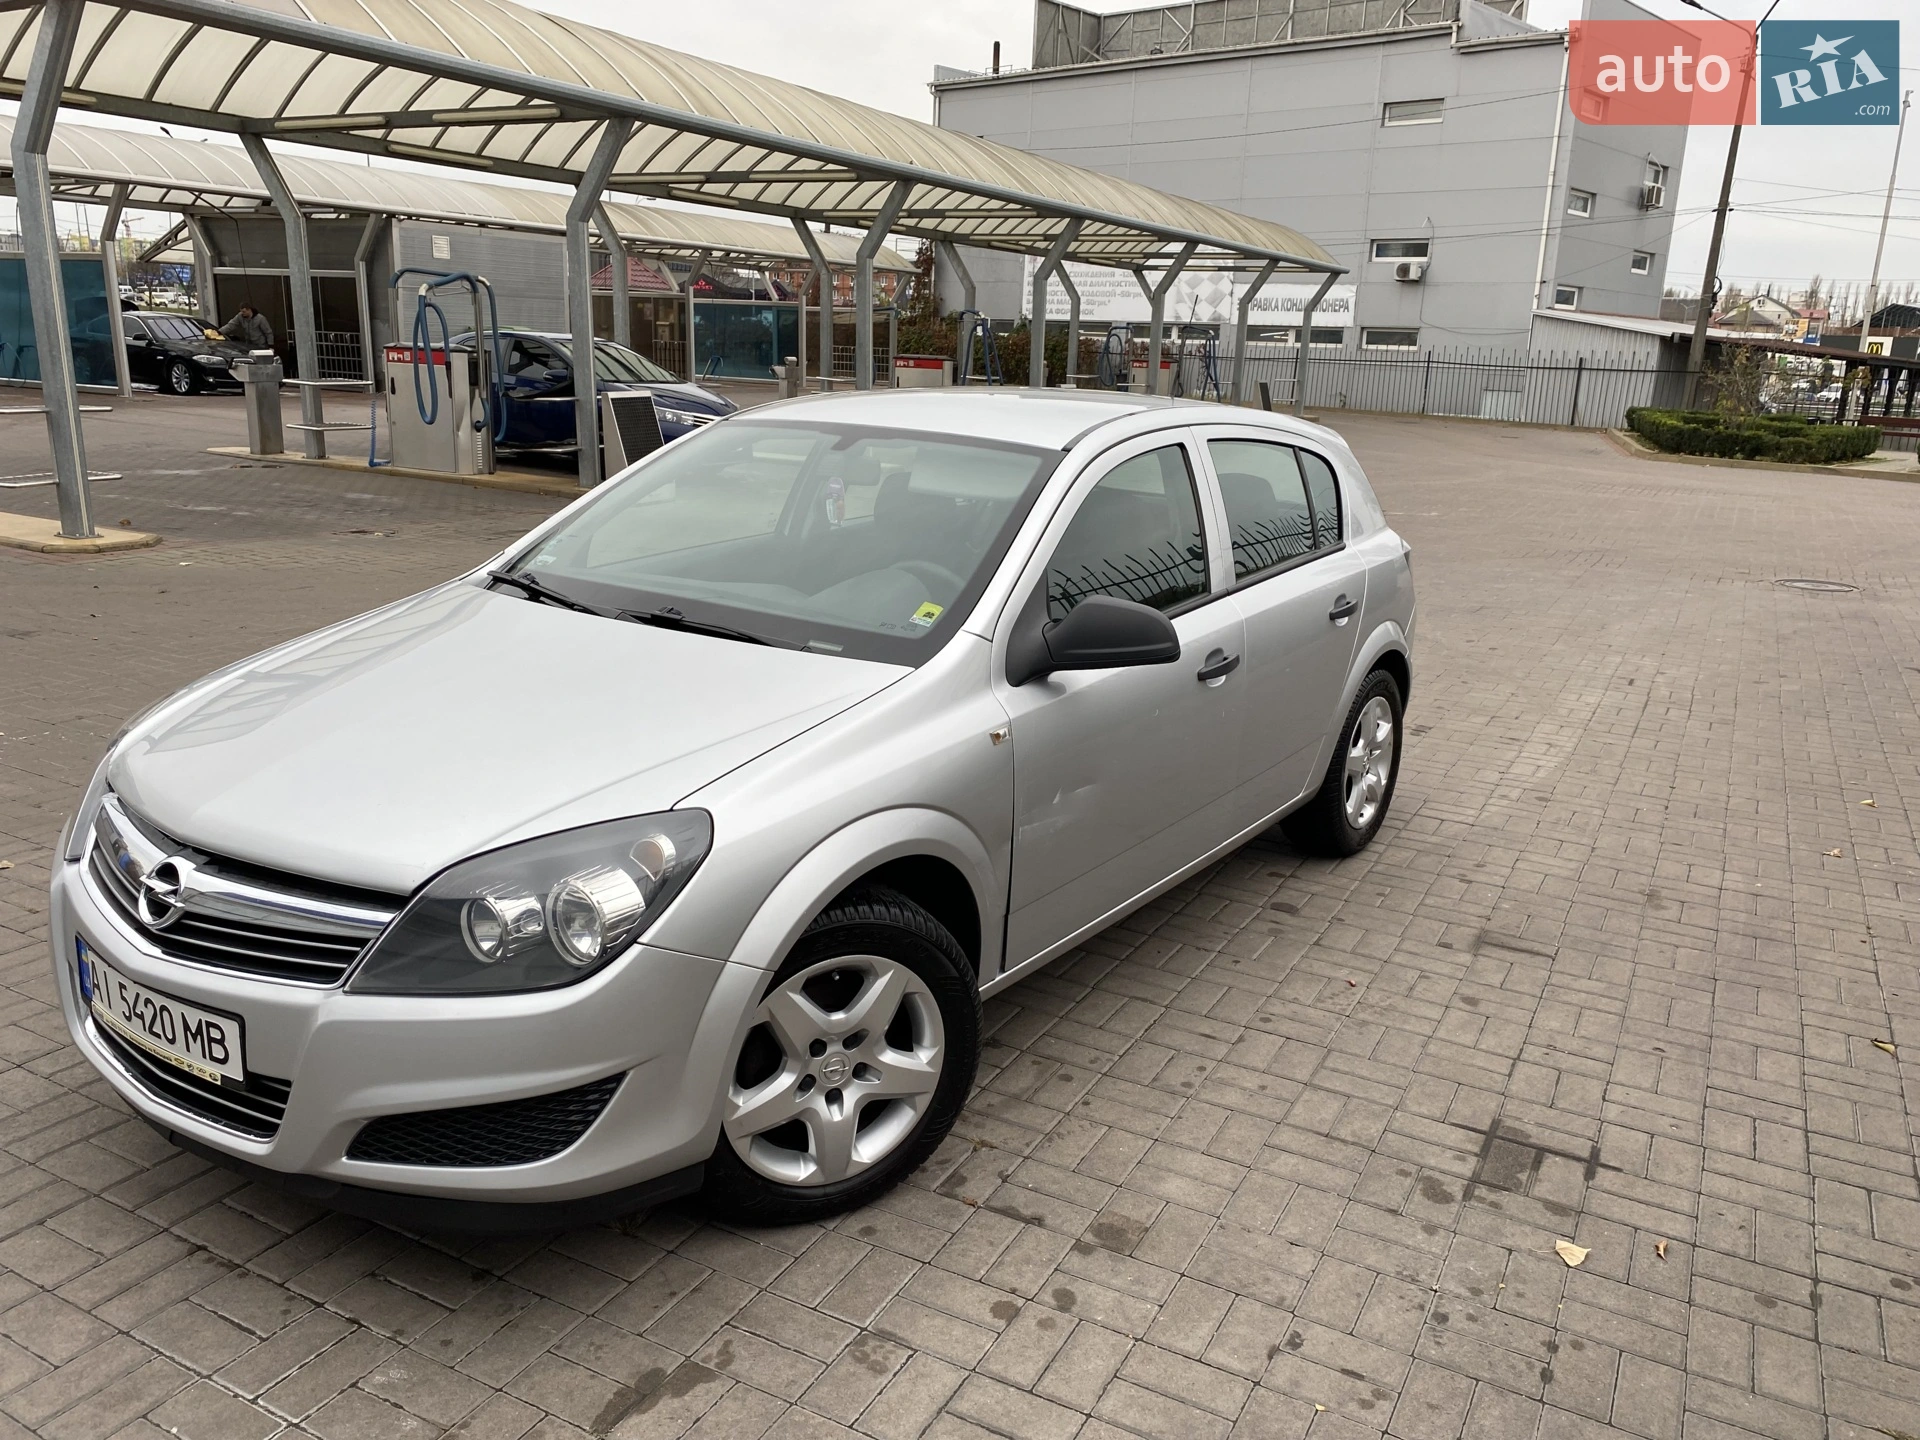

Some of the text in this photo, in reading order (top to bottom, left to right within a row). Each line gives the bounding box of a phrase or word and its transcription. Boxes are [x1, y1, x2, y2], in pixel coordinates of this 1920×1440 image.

[1281, 298, 1350, 312] КОНДИИОНЕРА
[91, 960, 112, 1010] AI
[118, 981, 176, 1045] 5420
[181, 1011, 230, 1065] MB
